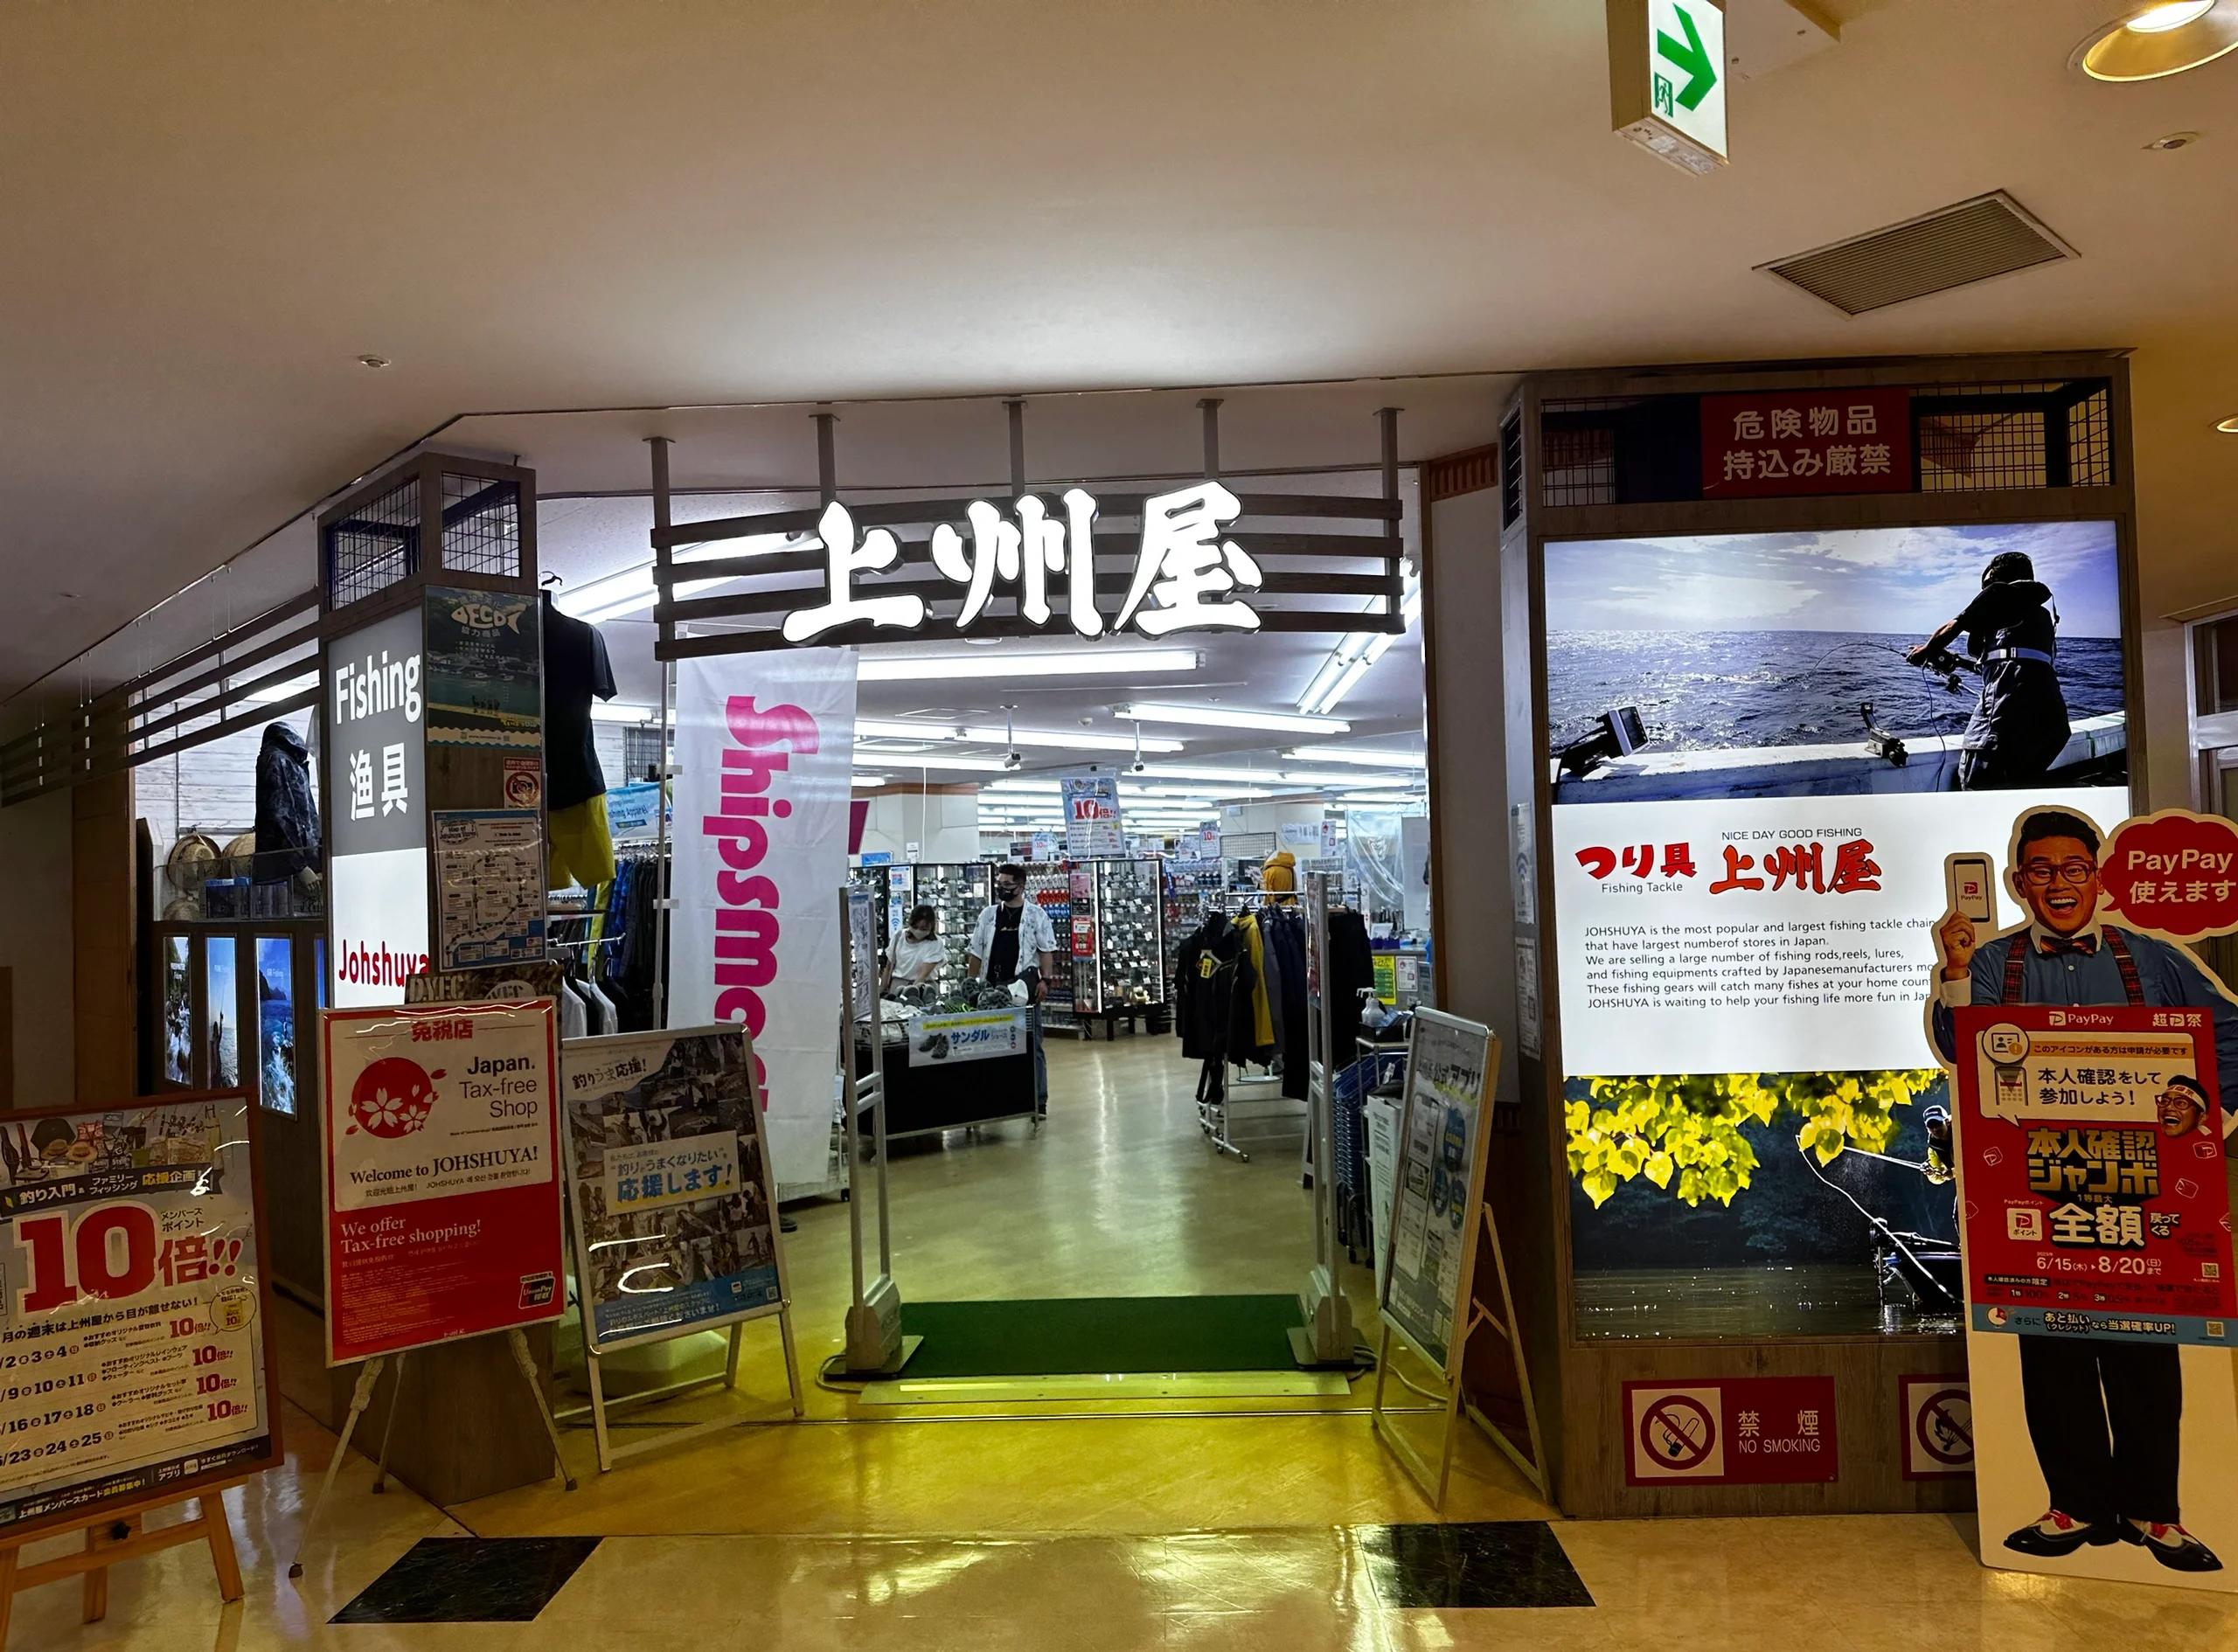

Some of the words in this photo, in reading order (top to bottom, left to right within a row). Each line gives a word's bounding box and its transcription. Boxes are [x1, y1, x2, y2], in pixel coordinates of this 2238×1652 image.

[1733, 405, 1878, 441] 危険物品
[1723, 444, 1891, 481] 持込み厳禁
[782, 480, 1263, 642] 上州屋
[336, 650, 422, 725] Fishing
[1722, 831, 1748, 841] NICE
[1752, 830, 1776, 840] DAY
[1779, 829, 1813, 839] GOOD
[1817, 827, 1863, 837] FISHING
[1574, 842, 1698, 880] つり具
[1709, 838, 1882, 895] 上州屋
[2128, 849, 2233, 876] PayPay
[1602, 882, 1643, 895] Fishing
[1646, 881, 1683, 892] Tackle
[2129, 879, 2238, 905] 使えます
[702, 696, 819, 1113] Shipsma
[1585, 926, 1647, 937] JOHSHUYA
[1650, 925, 1658, 935] is
[1661, 924, 1681, 935] the
[1684, 925, 1713, 934] most
[1716, 922, 1760, 936] popular
[1762, 921, 1784, 933] and
[1788, 921, 1826, 934] largest
[1829, 920, 1866, 933] fishing
[1869, 919, 1903, 930] tackle
[1585, 941, 1609, 951] that
[1612, 940, 1639, 951] have
[1642, 939, 1680, 952] largest
[1742, 938, 1776, 947] stores
[1779, 936, 1790, 947] in
[1793, 936, 1829, 948] Japan.
[339, 939, 430, 987] Johshuya
[1585, 955, 1605, 966] We
[1608, 956, 1627, 965] are
[1629, 954, 1665, 967] selling
[1668, 955, 1676, 964] a
[1679, 953, 1707, 966] large
[1711, 952, 1755, 963] number
[1758, 950, 1770, 962] of
[1774, 950, 1811, 963] fishing
[1874, 947, 1904, 959] lures,
[1586, 968, 1608, 980] and
[1611, 968, 1649, 982] fishing
[1651, 968, 1719, 981] equipments
[1721, 966, 1762, 977] crafted
[1765, 966, 1779, 978] by
[1587, 983, 1620, 994] These
[1622, 982, 1660, 996] fishing
[1664, 984, 1695, 996] gears
[1697, 981, 1717, 992] will
[1720, 980, 1750, 992] catch
[1754, 982, 1784, 993] many
[1787, 979, 1819, 990] fishes
[1822, 980, 1835, 989] at
[1837, 980, 1863, 991] your
[1866, 977, 1899, 988] home
[1588, 997, 1650, 1009] JOHSHUYA
[1653, 997, 1662, 1008] is
[1664, 997, 1706, 1010] waiting
[1709, 997, 1723, 1006] to
[1726, 995, 1751, 1008] help
[1753, 996, 1779, 1008] your
[1783, 994, 1819, 1007] fishing
[1823, 992, 1840, 1003] life
[1844, 994, 1873, 1003] more
[1876, 991, 1896, 1003] fun
[1900, 993, 1910, 1002] in
[2068, 1014, 2114, 1026] PayPay
[412, 1019, 474, 1042] 免税店
[951, 1029, 990, 1045] サンダル
[467, 1056, 535, 1078] Japan.
[2038, 1067, 2161, 1086] 本人確認をして
[459, 1078, 538, 1100] Tax-free
[2039, 1086, 2136, 1106] 参加しよう!
[490, 1100, 539, 1121] Shop
[2026, 1128, 2158, 1162] 本人確認
[350, 1167, 413, 1185] Welcome
[415, 1163, 429, 1177] to
[432, 1146, 539, 1177] JOHSHUYA!
[89, 1180, 138, 1195] フィッシング
[92, 1173, 135, 1186] ファミリー
[617, 1163, 733, 1203] 応援します!
[2027, 1159, 2160, 1196] ジャンボ
[19, 1185, 77, 1205] 釣り入門
[162, 1218, 205, 1233] ポイント
[341, 1222, 366, 1238] We
[370, 1216, 407, 1233] offer
[2049, 1202, 2145, 1246] 全額
[2150, 1212, 2180, 1225] 戻って
[340, 1234, 406, 1254] Tax-free
[408, 1219, 481, 1243] shopping!
[2151, 1225, 2171, 1236] くる
[2014, 1315, 2041, 1326] さらに
[2044, 1311, 2090, 1324] あと払い
[1738, 1440, 1757, 1454] NO
[1762, 1439, 1821, 1454] SMOKING
